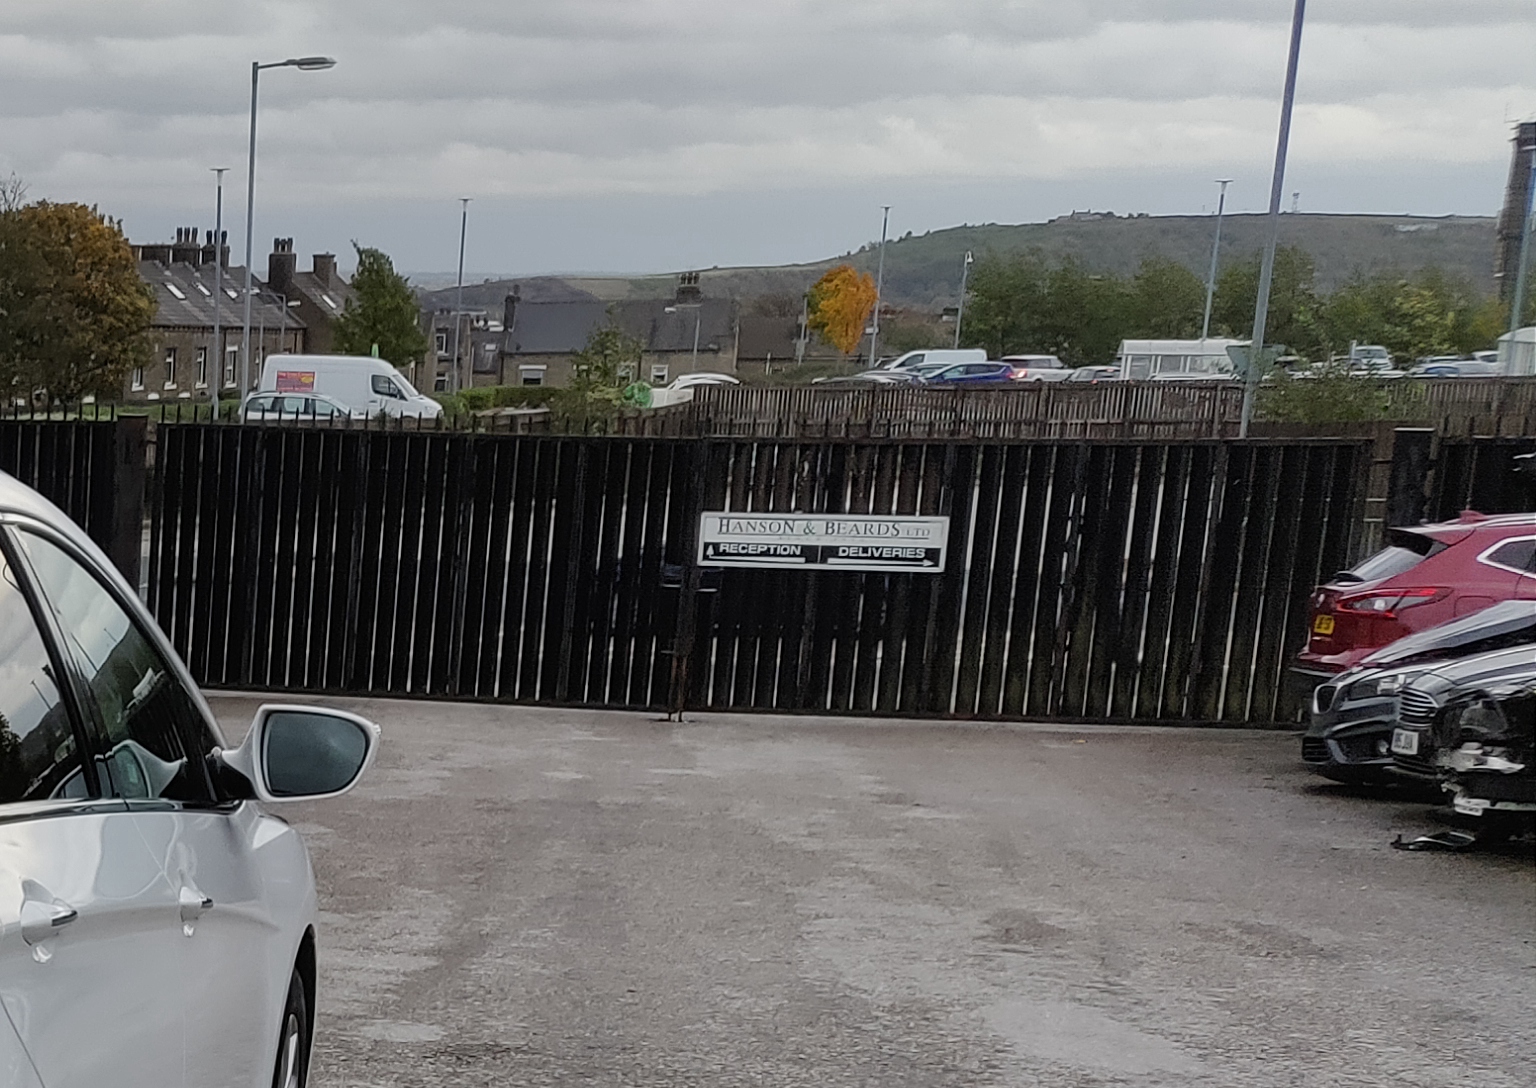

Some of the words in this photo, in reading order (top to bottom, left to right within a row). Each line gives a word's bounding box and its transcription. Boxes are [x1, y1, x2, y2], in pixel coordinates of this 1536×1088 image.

[717, 517, 795, 535] HANSON
[803, 521, 816, 534] &
[825, 521, 900, 537] BEARDS
[719, 543, 801, 555] RECEPTION
[839, 547, 926, 559] DELIVERIES
